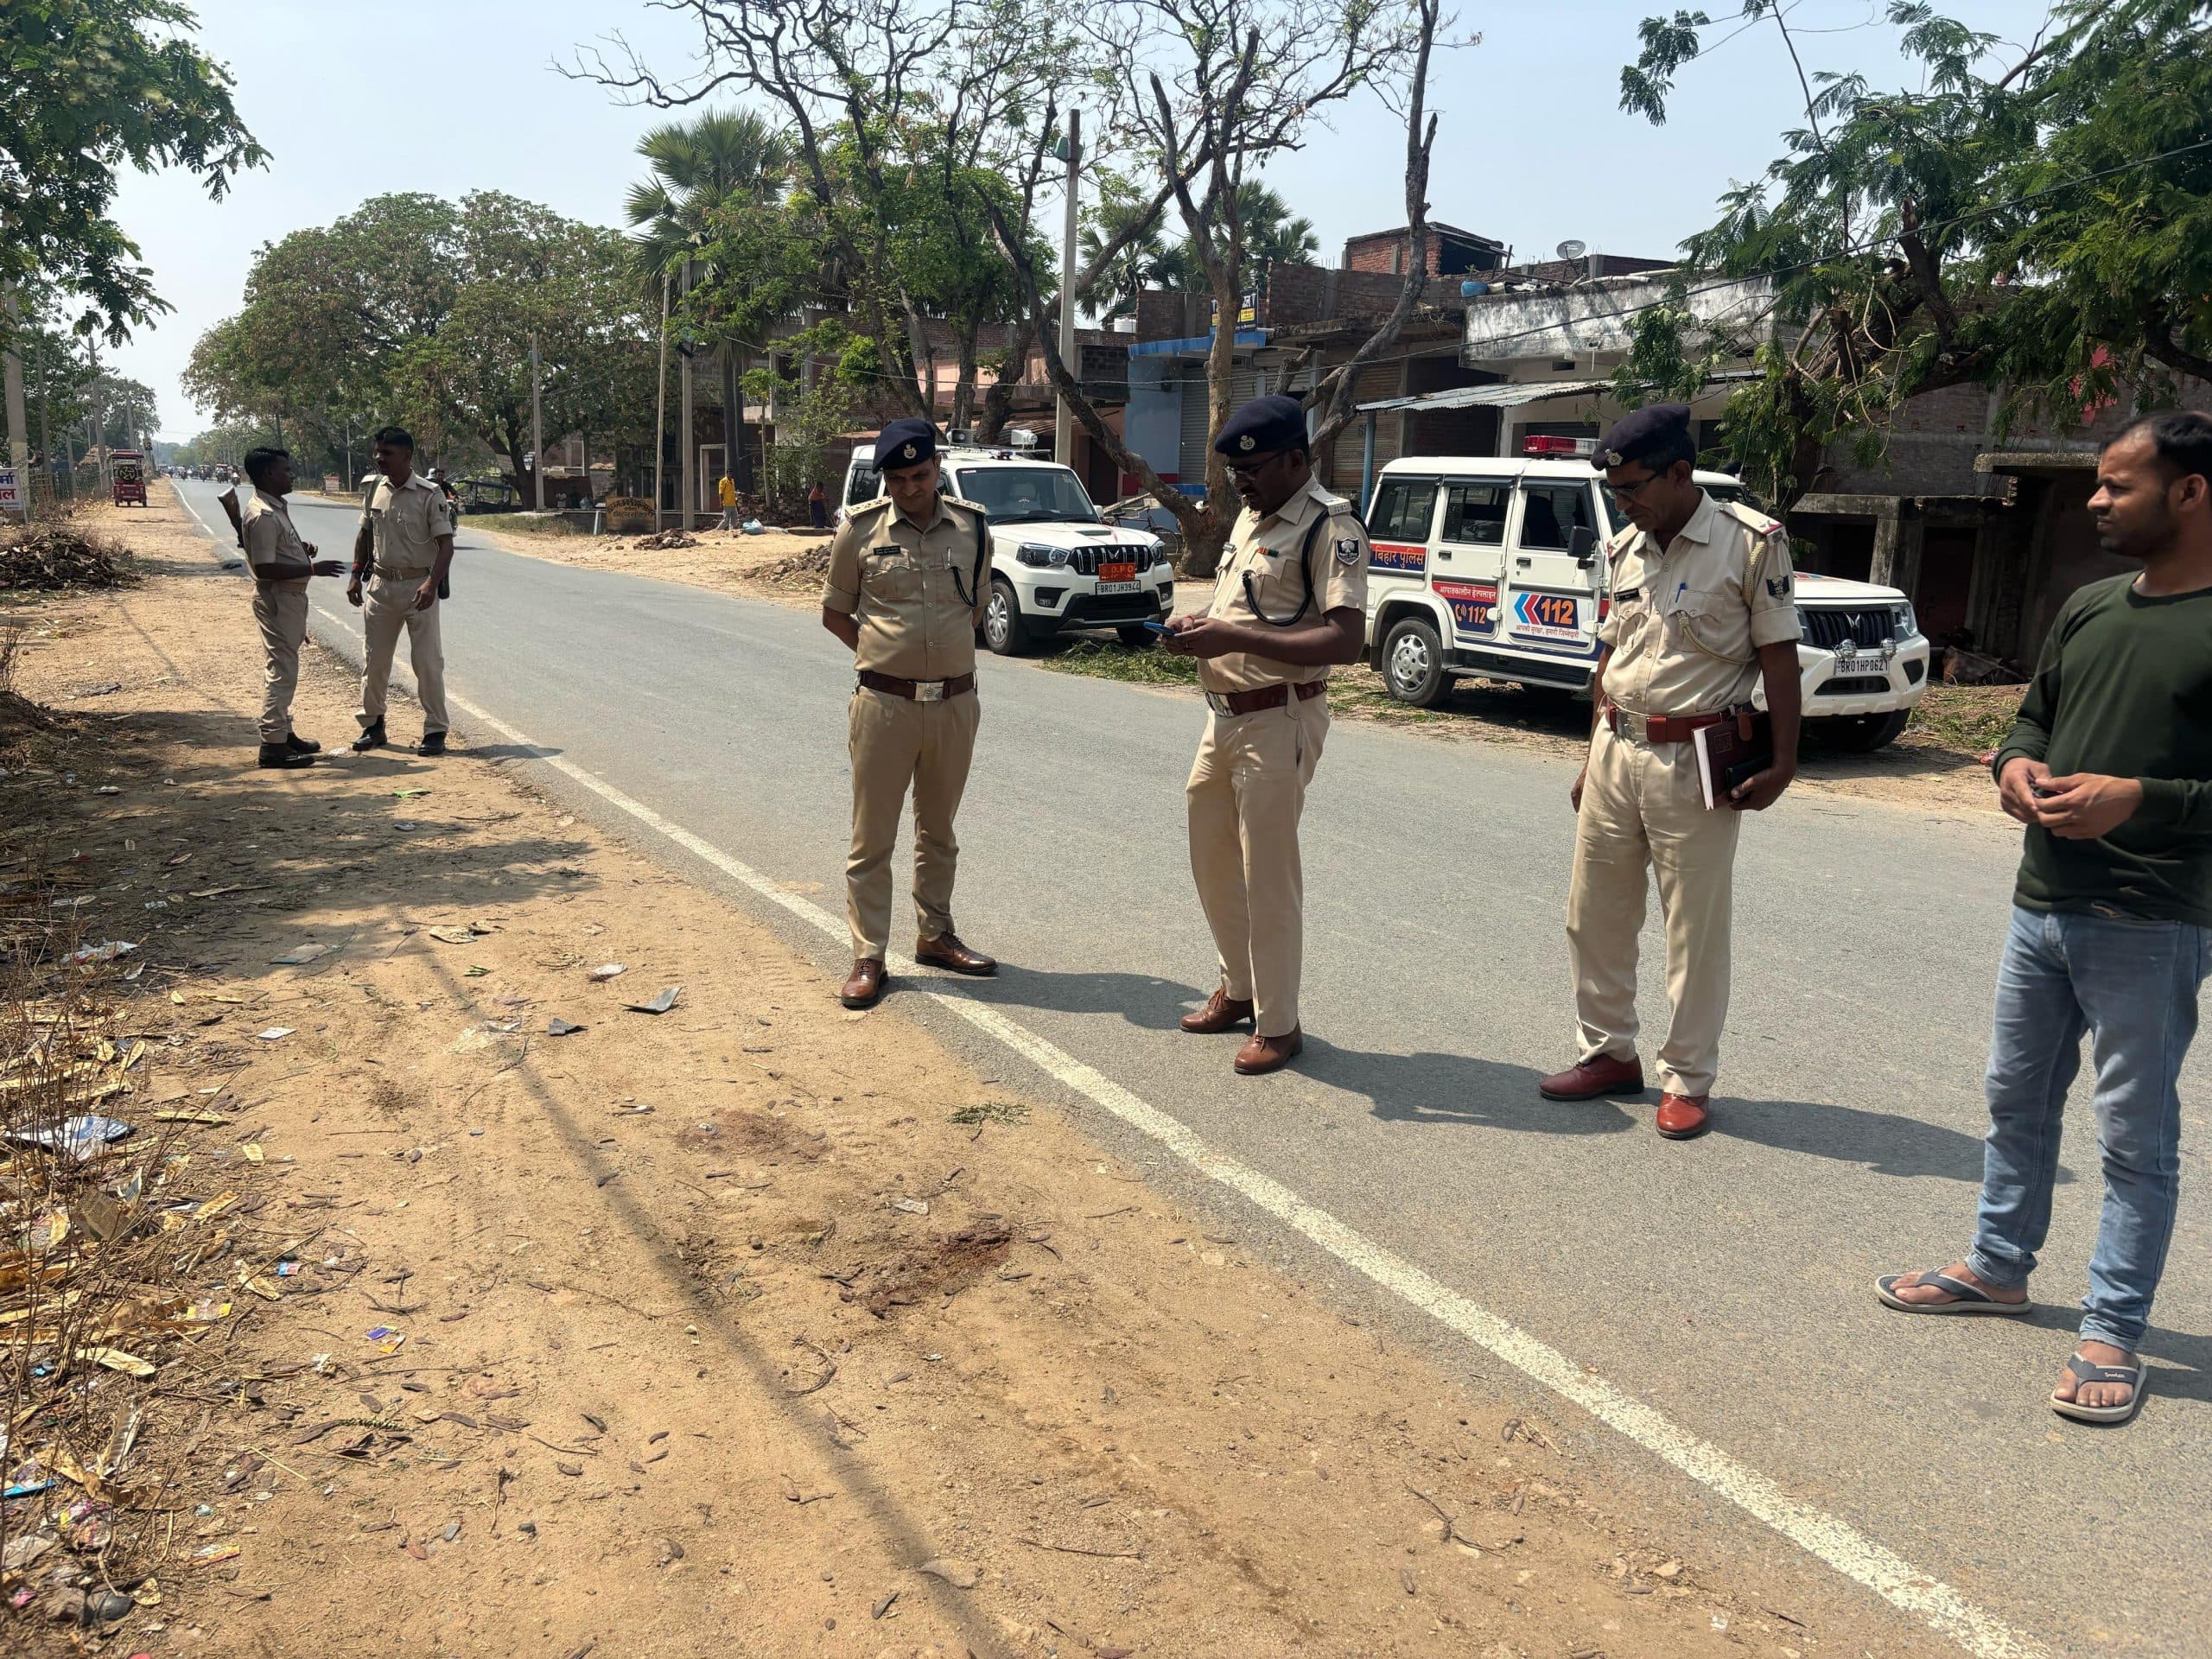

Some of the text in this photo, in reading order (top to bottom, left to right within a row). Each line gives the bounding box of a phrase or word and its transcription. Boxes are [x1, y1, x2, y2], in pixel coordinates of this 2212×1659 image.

[1375, 545, 1396, 565] बिहार
[1400, 548, 1424, 569] पुलिस
[1101, 582, 1140, 593] BR01JH3944
[1440, 586, 1497, 600] आपातकालीन हेल्पलाइन
[1468, 606, 1486, 625] 112
[1541, 598, 1573, 625] 112
